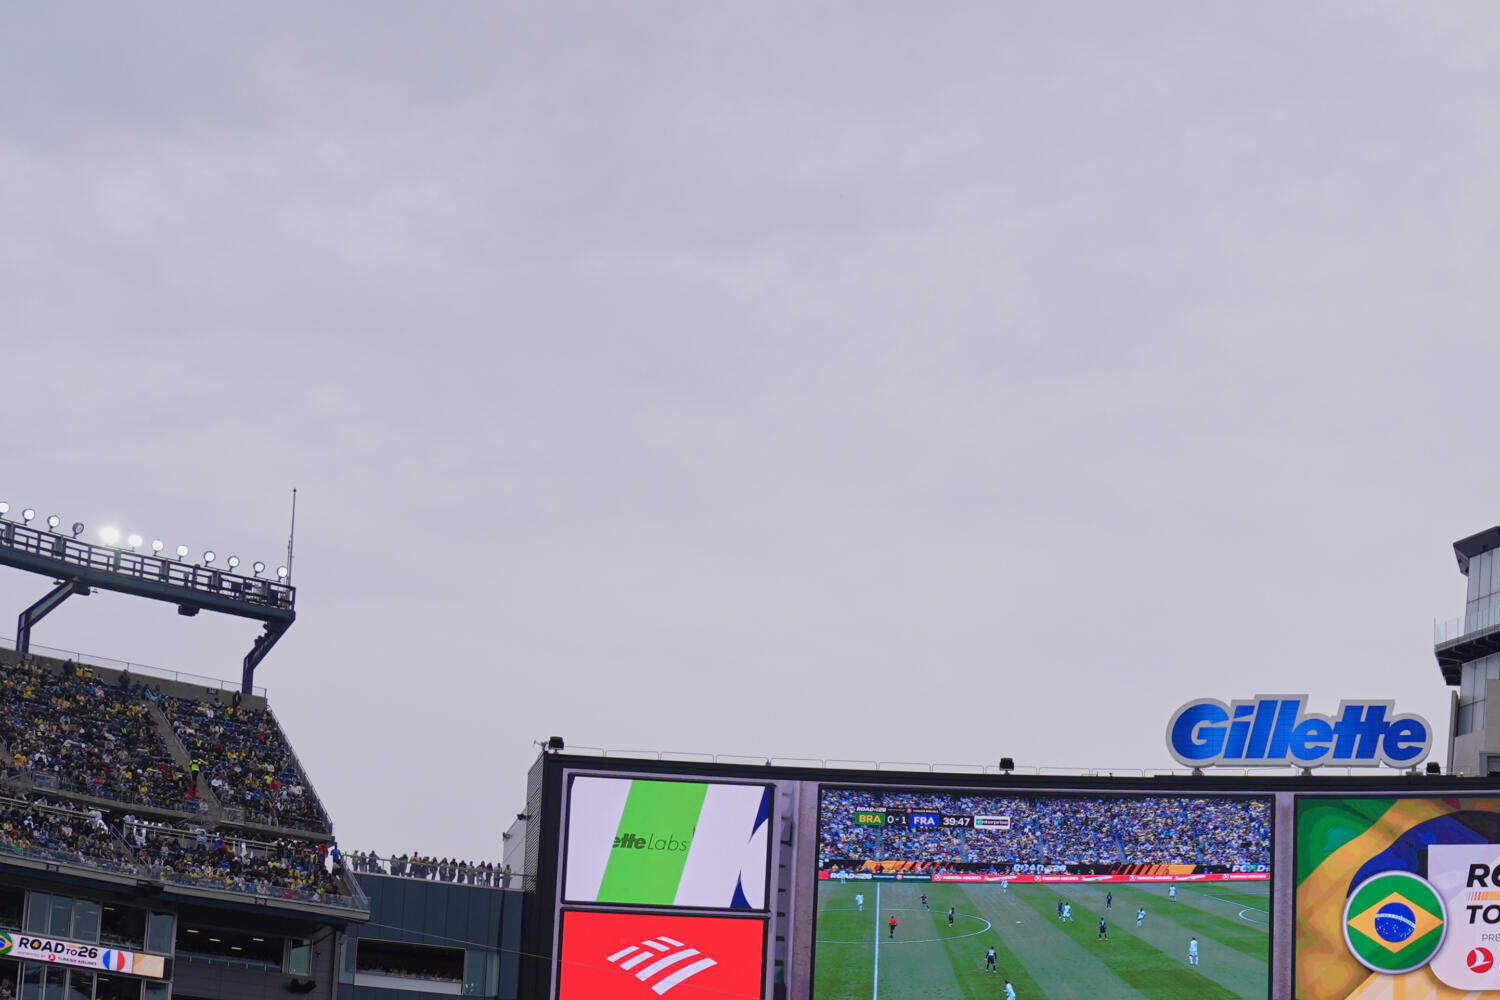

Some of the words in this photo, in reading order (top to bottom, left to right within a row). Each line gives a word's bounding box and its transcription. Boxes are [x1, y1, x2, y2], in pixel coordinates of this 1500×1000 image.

[1172, 699, 1427, 762] Gillette
[859, 815, 882, 824] BRA
[913, 817, 936, 826] FRA
[943, 817, 970, 826] 39:47
[19, 937, 65, 954] ROAD
[66, 946, 77, 956] TO
[77, 946, 98, 959] 26
